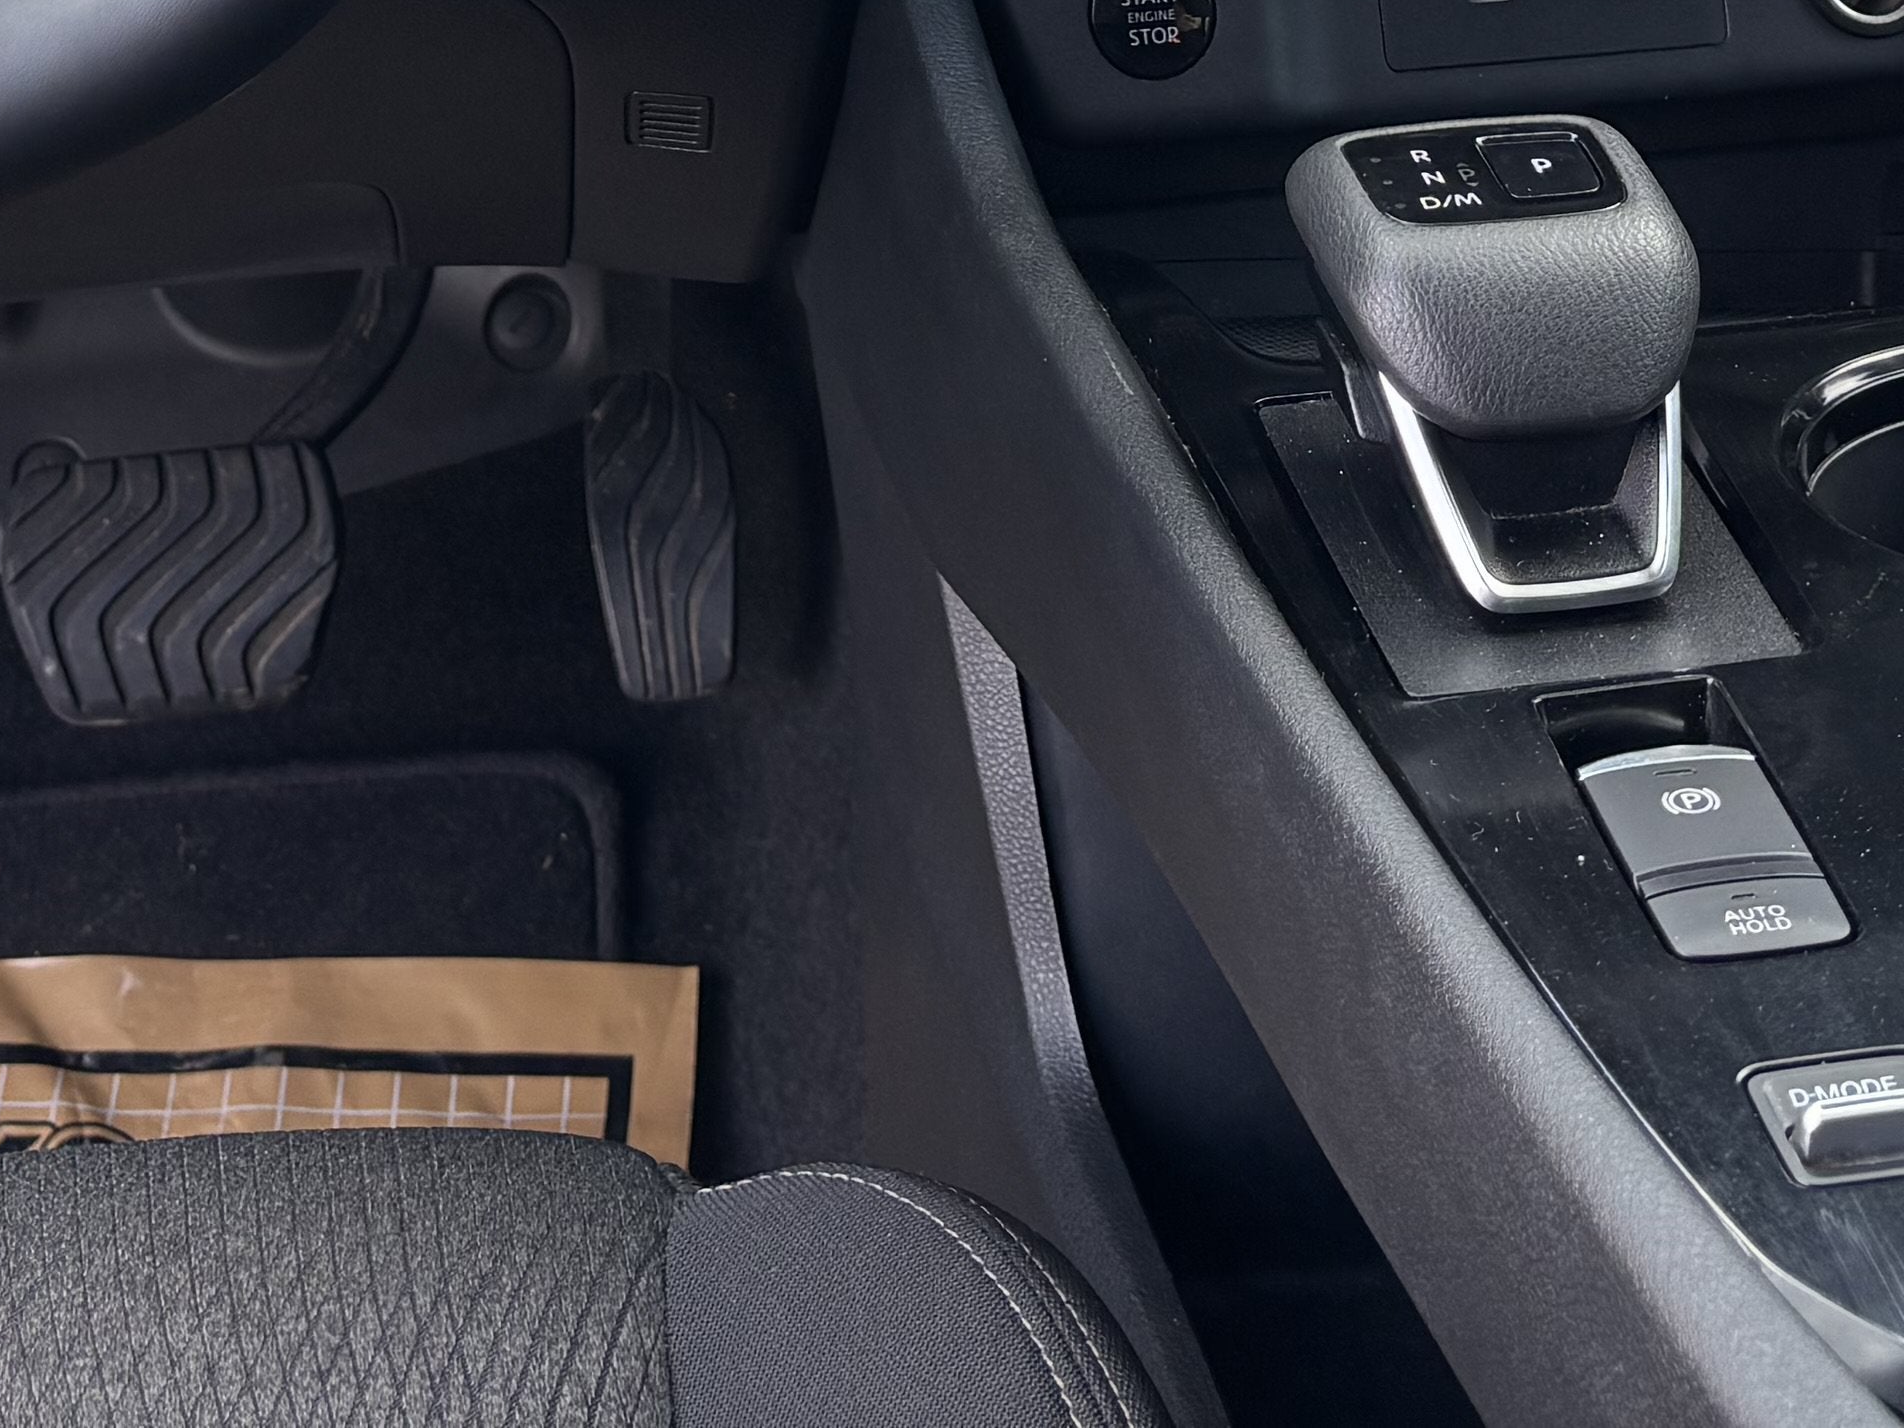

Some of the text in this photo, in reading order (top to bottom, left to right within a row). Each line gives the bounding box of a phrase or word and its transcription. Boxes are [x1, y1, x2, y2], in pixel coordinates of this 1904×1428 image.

[1127, 8, 1177, 24] ENGINE
[1129, 26, 1179, 46] STOP
[1410, 149, 1432, 163] R
[1530, 158, 1552, 174] P
[1421, 171, 1446, 186] N
[1419, 191, 1484, 211] D/M
[1723, 903, 1788, 924] AUTO
[1728, 915, 1794, 936] HOLD
[1788, 1075, 1898, 1108] D-MODE
